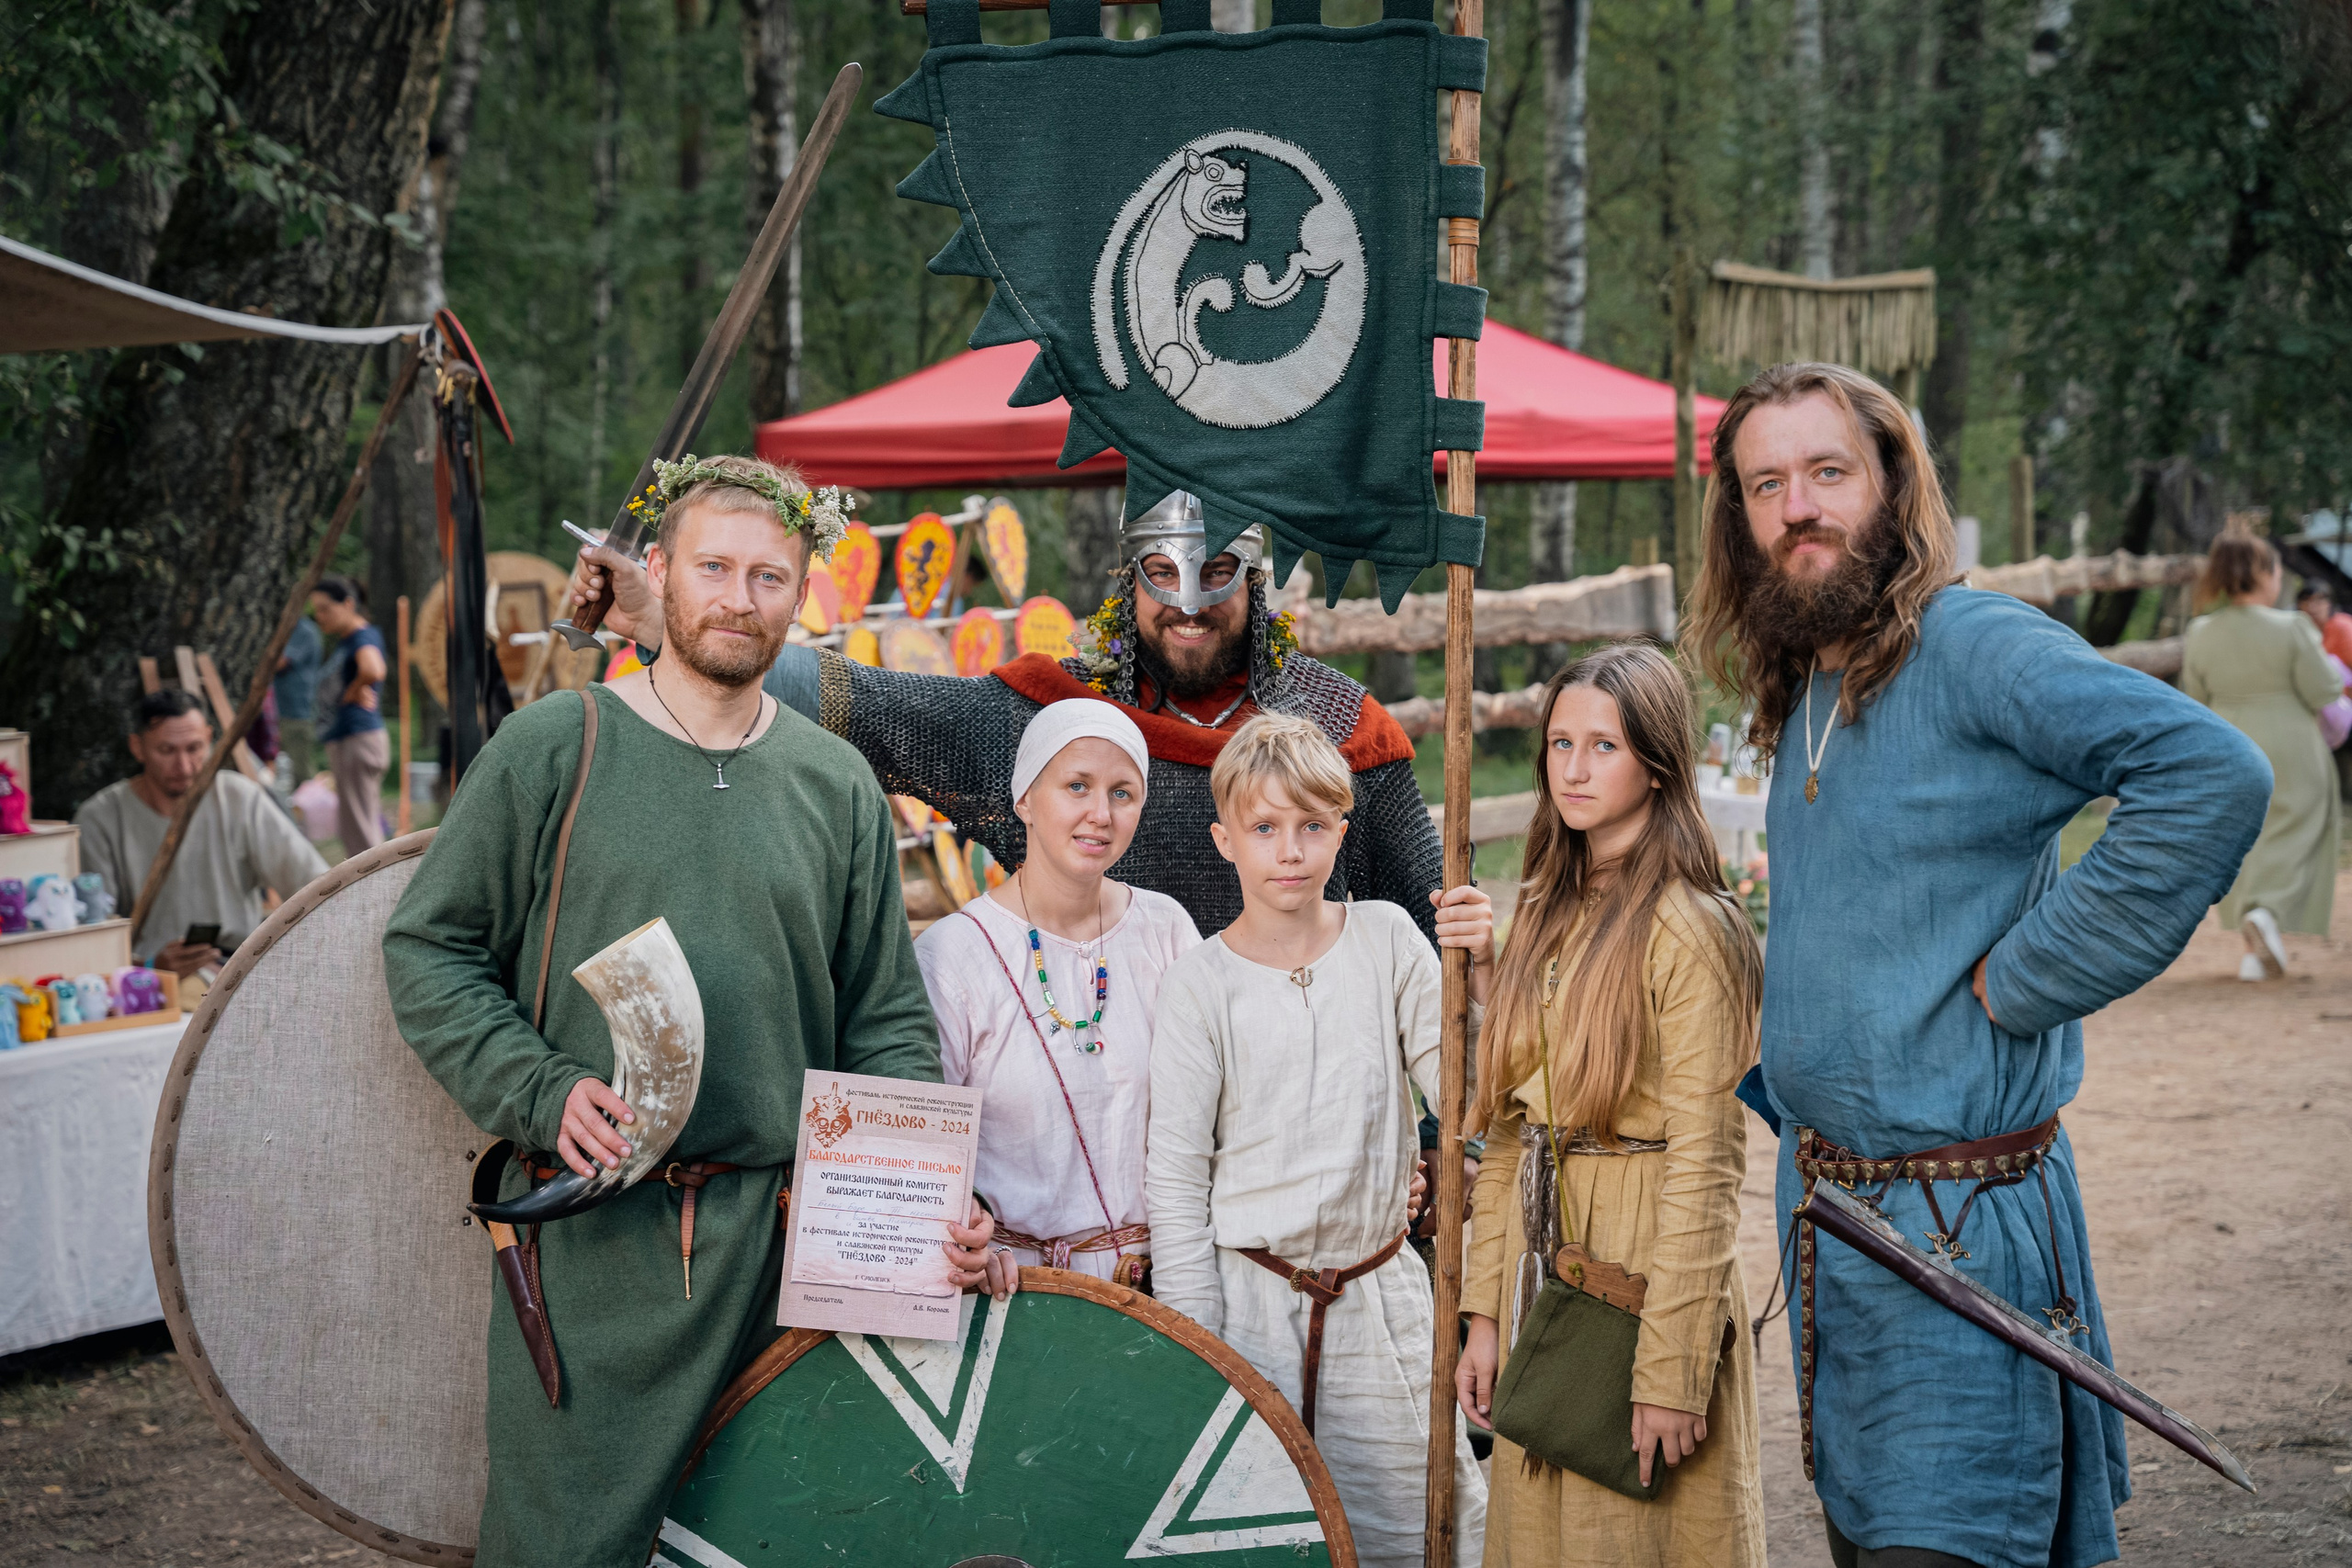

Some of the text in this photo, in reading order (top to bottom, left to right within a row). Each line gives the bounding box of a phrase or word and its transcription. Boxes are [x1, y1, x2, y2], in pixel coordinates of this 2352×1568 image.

[845, 1089, 974, 1109] фестиваль исторической реконструкции
[905, 1103, 942, 1112] славянской
[943, 1108, 973, 1118] культуры
[856, 1109, 927, 1130] ГНЁЗДОВО
[940, 1120, 971, 1135] 2024
[918, 1161, 962, 1175] ПИСЬМО
[820, 1171, 948, 1192] ОРГАНИЗАЦИОННЫЙ КОМИТЕТ
[826, 1186, 944, 1206] ВЫРАЖАЕТ БЛАГОДАРНОСТЬ
[869, 1224, 899, 1232] участие
[809, 1226, 850, 1237] фестивале
[852, 1231, 903, 1242] исторической
[904, 1235, 959, 1248] реконструки
[843, 1241, 887, 1251] славянской
[888, 1245, 923, 1256] культуры
[894, 1256, 919, 1267] 2024"
[803, 1293, 844, 1304] Председатель
